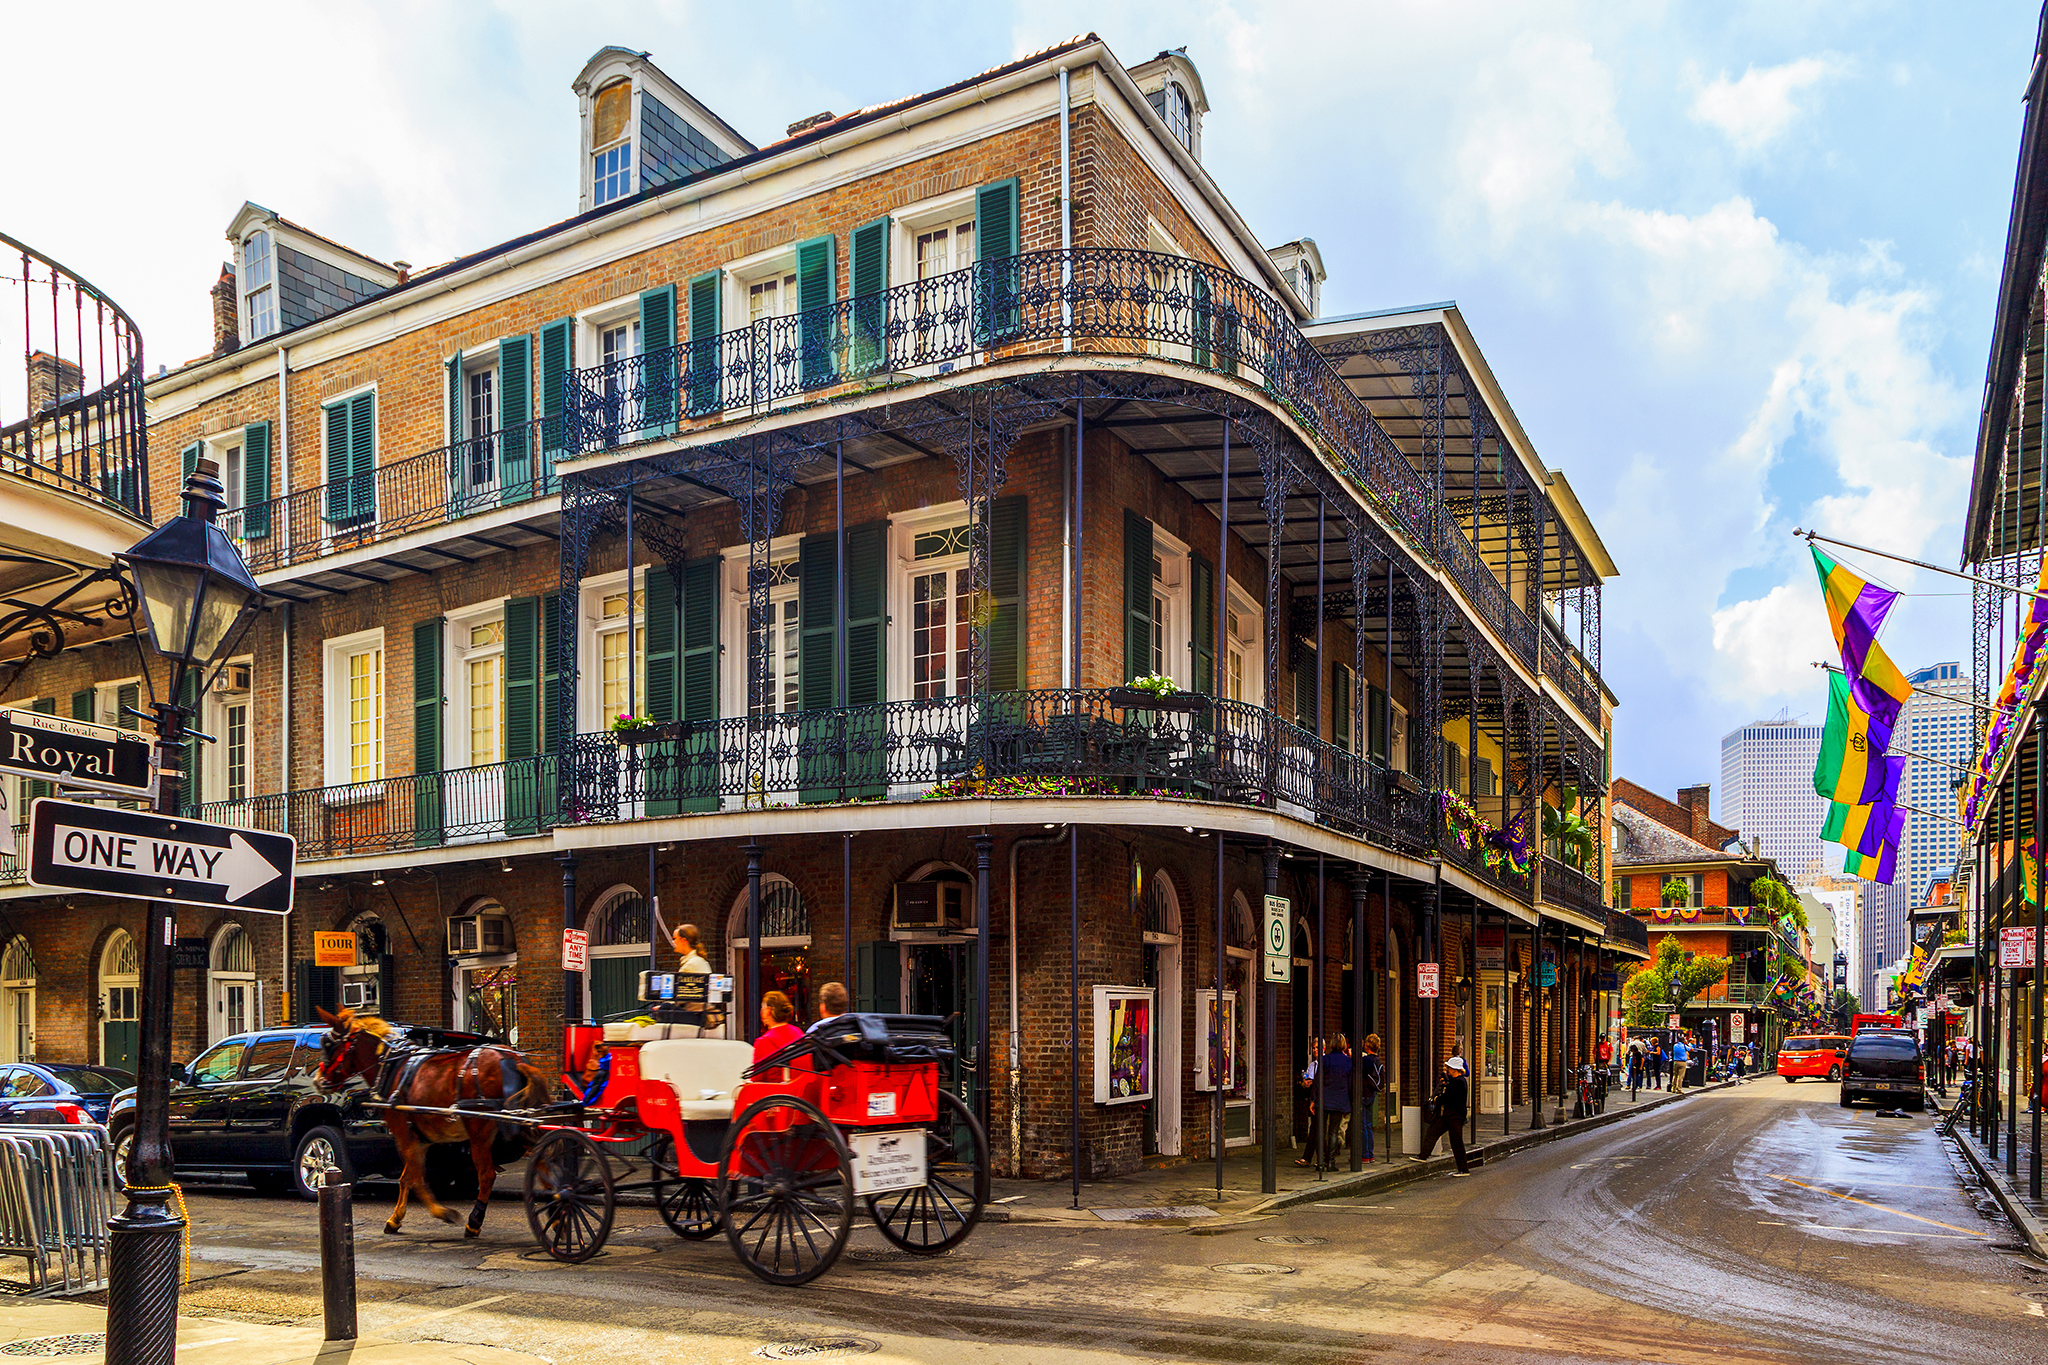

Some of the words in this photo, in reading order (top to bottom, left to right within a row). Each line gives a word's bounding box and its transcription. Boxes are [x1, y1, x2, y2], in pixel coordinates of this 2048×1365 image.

[32, 717, 55, 730] Rue
[59, 722, 98, 738] Royale
[9, 731, 116, 776] Royal
[64, 831, 138, 869] ONE
[152, 842, 223, 879] WAY
[2001, 931, 2009, 939] NO
[319, 939, 353, 949] TOUR
[176, 954, 204, 965] STERLING
[568, 951, 583, 959] TIME
